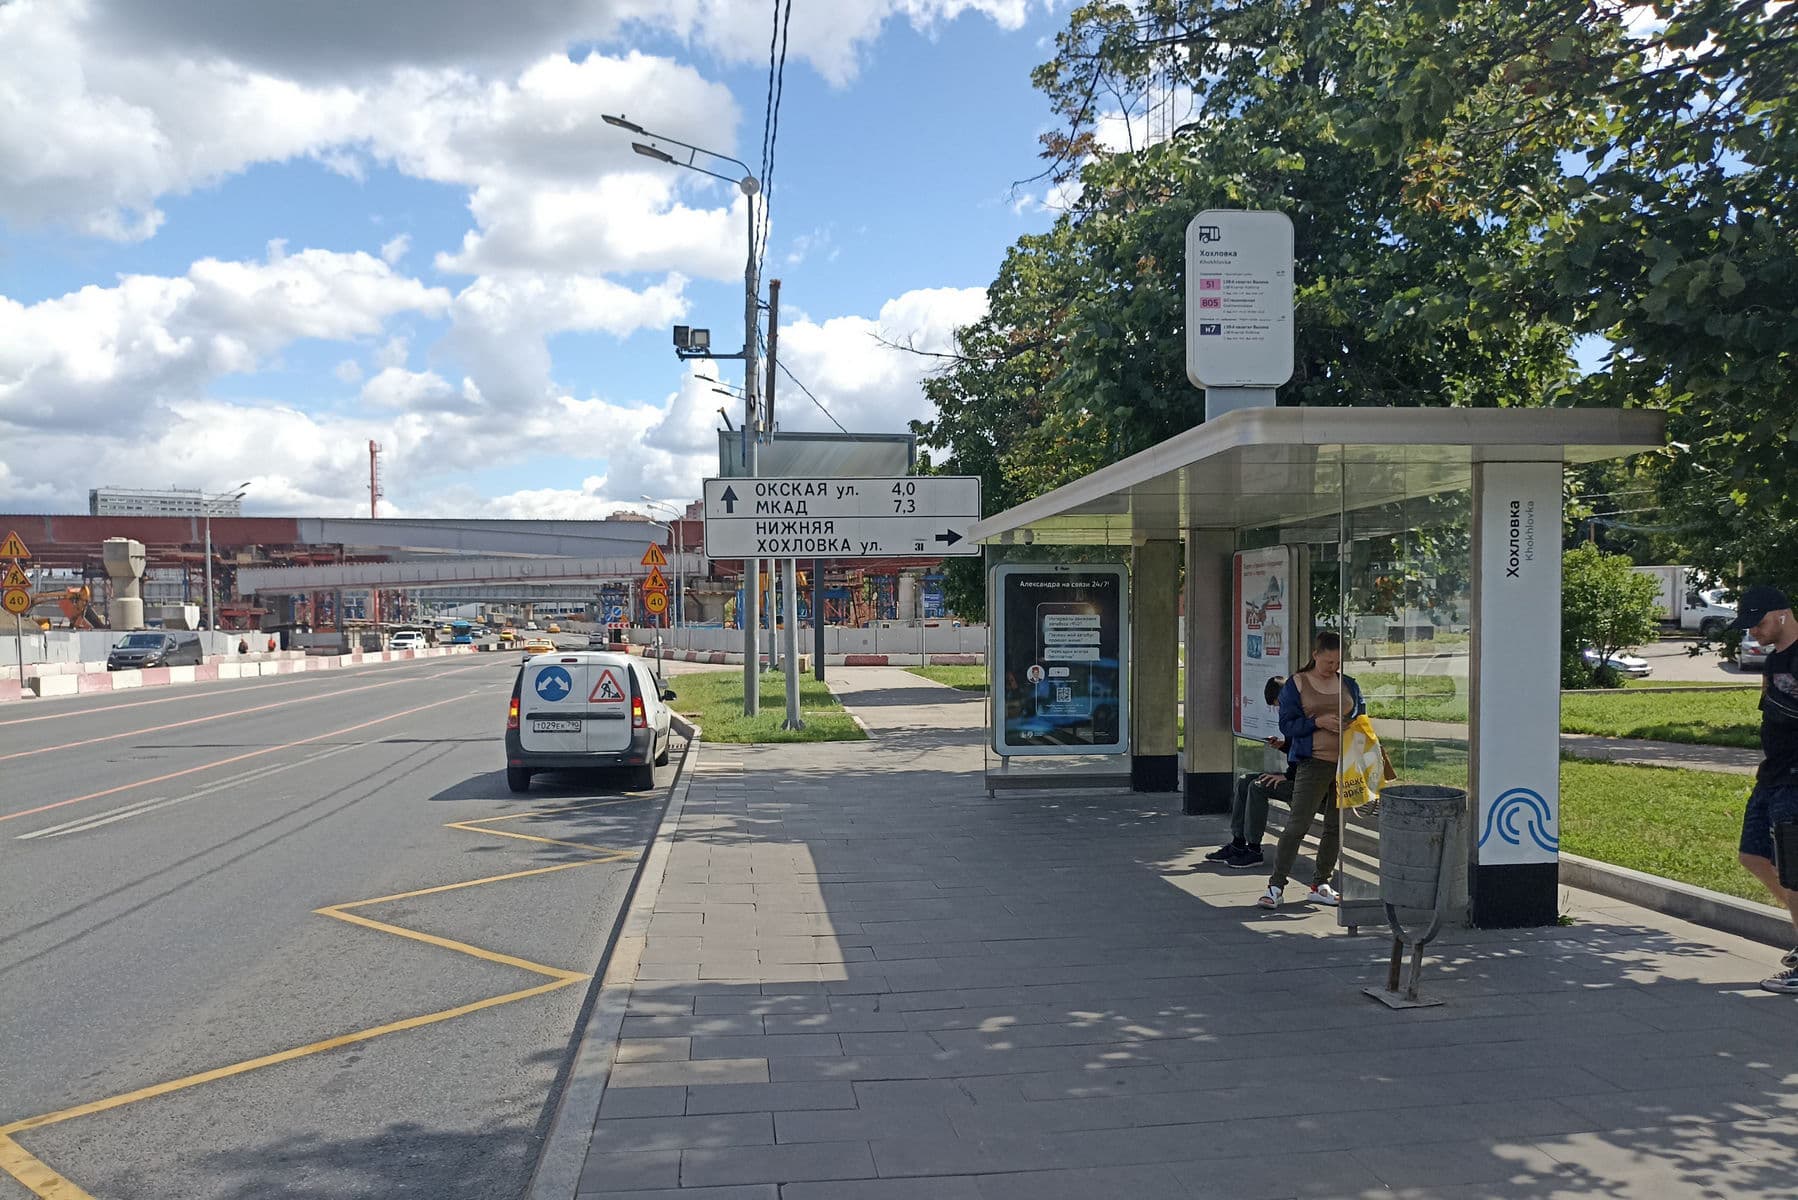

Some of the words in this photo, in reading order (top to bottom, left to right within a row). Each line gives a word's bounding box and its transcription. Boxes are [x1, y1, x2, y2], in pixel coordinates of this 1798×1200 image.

[1206, 280, 1215, 289] 51
[1202, 298, 1219, 307] 805
[755, 482, 828, 497] ОКСКАЯ
[836, 485, 859, 500] ул.
[891, 481, 916, 498] 4,0
[756, 500, 809, 516] МКАД
[893, 499, 916, 514] 7,3
[756, 520, 834, 536] НИЖНЯЯ
[1524, 500, 1535, 561] Khokhlovka
[757, 537, 852, 553] ХОХЛОВКА
[860, 541, 883, 555] ул.
[1506, 500, 1520, 578] Хохловка
[1019, 580, 1061, 589] Александра
[9, 596, 24, 605] 40
[650, 597, 663, 606] 40
